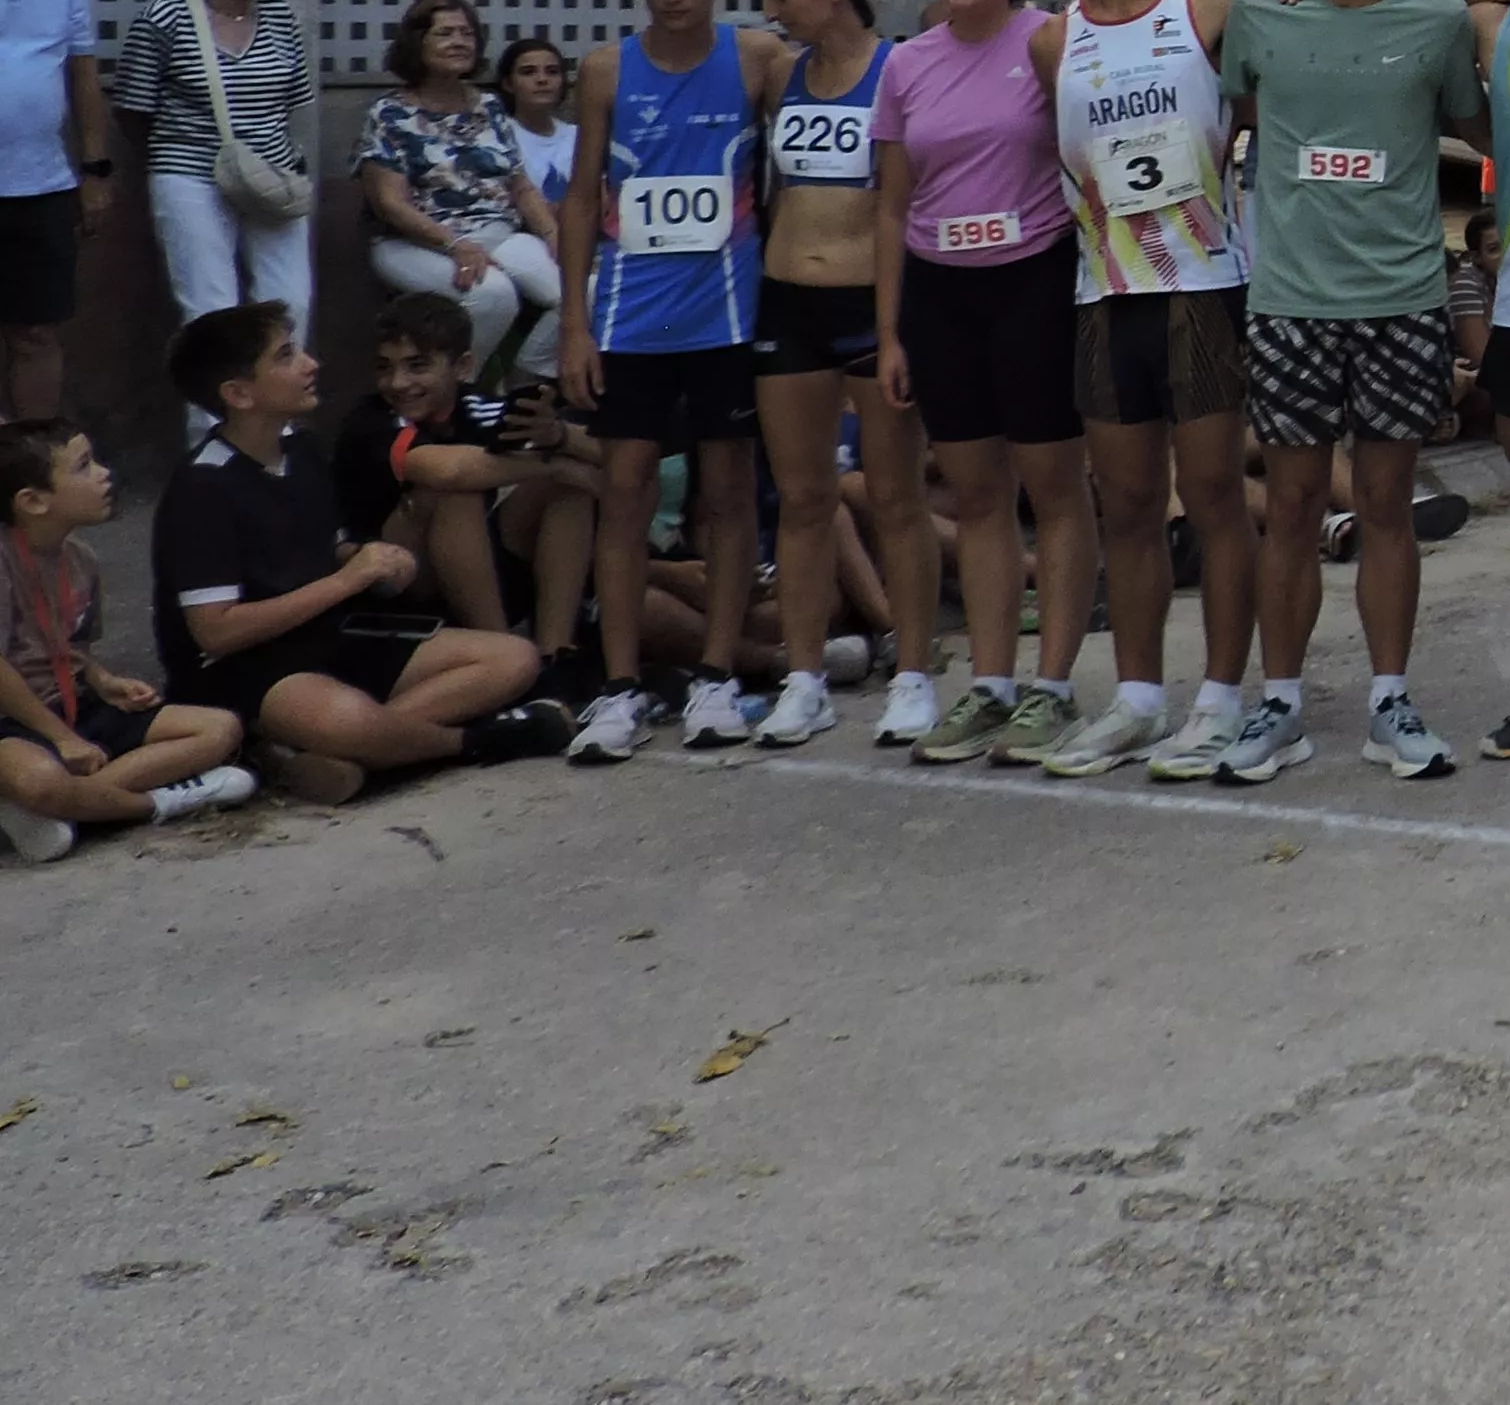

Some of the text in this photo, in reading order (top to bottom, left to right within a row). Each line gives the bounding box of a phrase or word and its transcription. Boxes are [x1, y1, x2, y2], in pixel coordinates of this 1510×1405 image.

[1088, 81, 1178, 127] ARAGÓN
[781, 115, 862, 153] 226
[1125, 156, 1164, 191] 3
[1310, 153, 1372, 179] 592
[635, 187, 719, 226] 100
[947, 219, 1005, 246] 596
